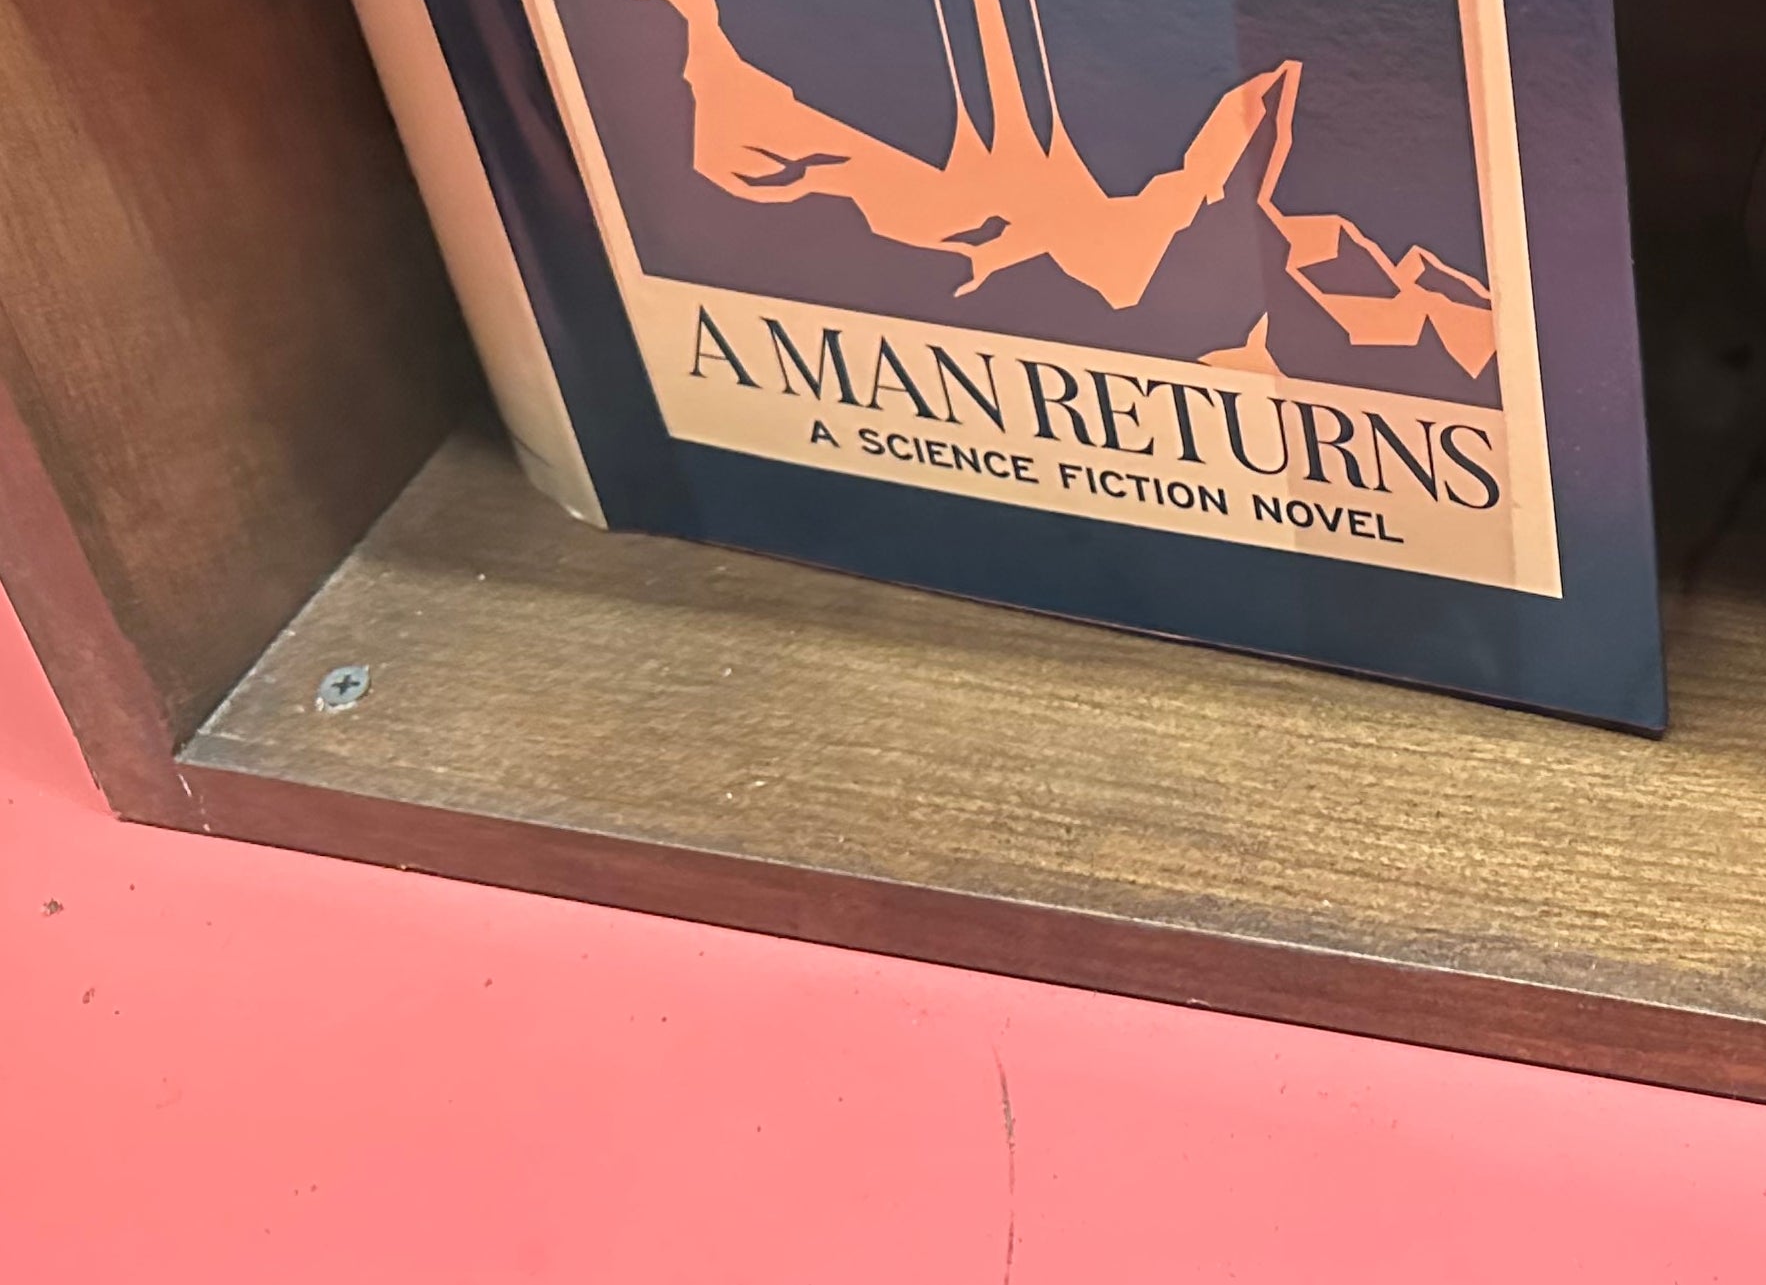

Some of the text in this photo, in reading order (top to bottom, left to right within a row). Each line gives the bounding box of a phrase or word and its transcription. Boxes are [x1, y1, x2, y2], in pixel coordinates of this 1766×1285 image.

[689, 303, 1502, 512] A MAN RETURNS
[810, 420, 1406, 544] A SCIENCE FICTION NOVEL
